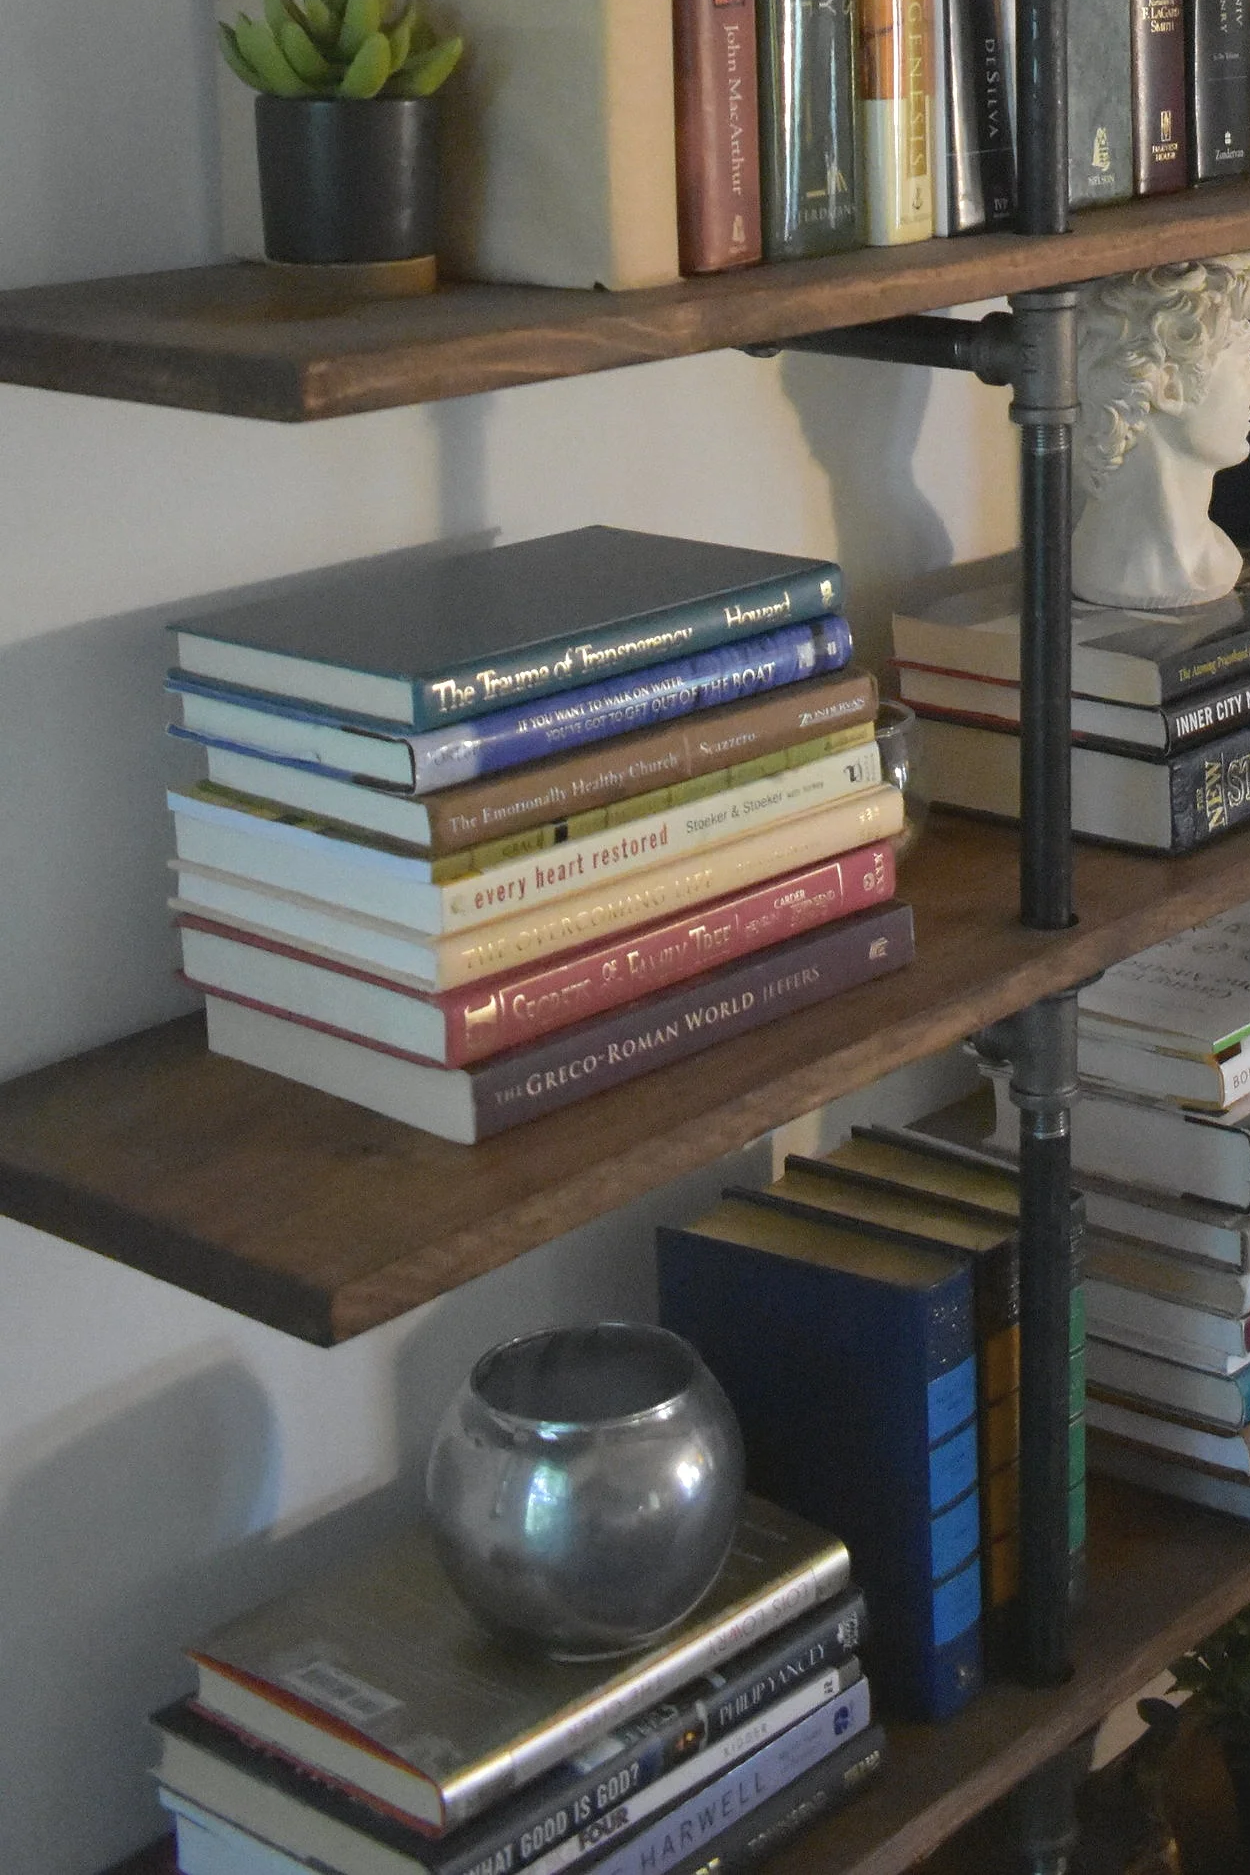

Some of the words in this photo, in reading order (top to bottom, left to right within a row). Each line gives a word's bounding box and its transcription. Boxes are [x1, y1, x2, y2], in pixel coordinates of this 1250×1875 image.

[722, 23, 741, 73] John
[907, 0, 925, 168] GENESIS
[431, 677, 475, 713] The
[475, 660, 550, 699] Trauma
[553, 650, 575, 683] of
[575, 628, 694, 676] Transparency
[724, 591, 791, 629] Howard
[1175, 709, 1214, 738] INNER
[1215, 694, 1243, 721] CITY
[448, 815, 479, 835] The
[480, 782, 569, 827] Emotionally
[570, 769, 626, 799] Healthy
[627, 752, 680, 785] Church
[698, 730, 757, 757] Scazzero
[1204, 760, 1227, 833] NEW
[474, 877, 527, 911] every
[534, 852, 585, 890] heart
[591, 825, 670, 871] restored
[685, 809, 730, 835] Stoeker
[730, 808, 741, 821] &
[742, 792, 784, 818] Stoeker
[494, 1083, 526, 1103] THE
[525, 1020, 680, 1099] GRECO-ROMAN
[683, 990, 755, 1032] WORLD
[716, 1685, 765, 1727] PHILIP
[763, 1641, 828, 1695] YANCEY
[519, 1810, 568, 1860] GOOD
[573, 1796, 593, 1823] IS
[595, 1760, 642, 1805] GOD?
[637, 1769, 769, 1869] HARWELL
